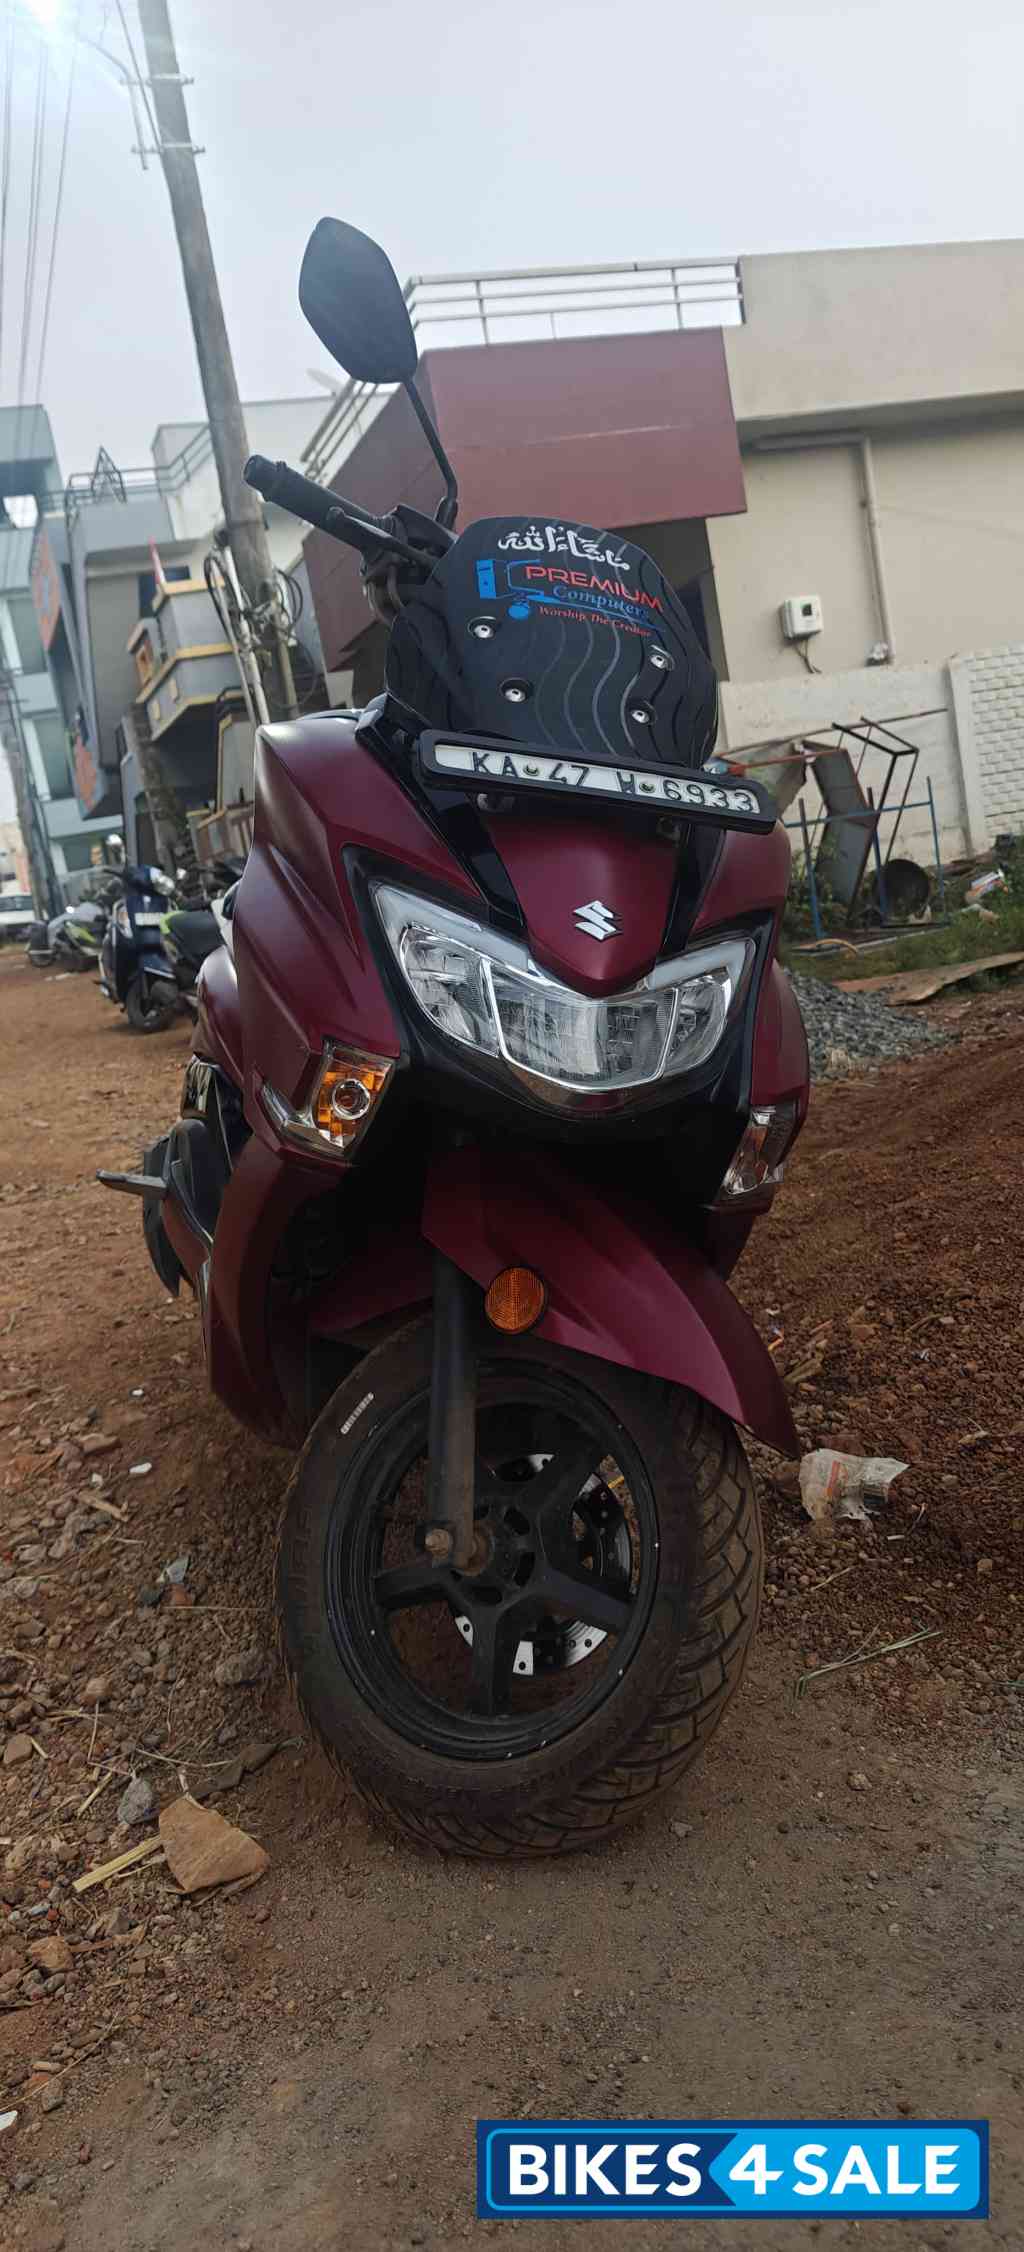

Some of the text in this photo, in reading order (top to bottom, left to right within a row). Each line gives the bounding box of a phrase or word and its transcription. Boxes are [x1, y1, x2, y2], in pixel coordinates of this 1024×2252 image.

[525, 566, 664, 613] PREMIUM
[472, 751, 519, 777] KA
[548, 762, 590, 788] 47
[663, 778, 755, 813] 6933
